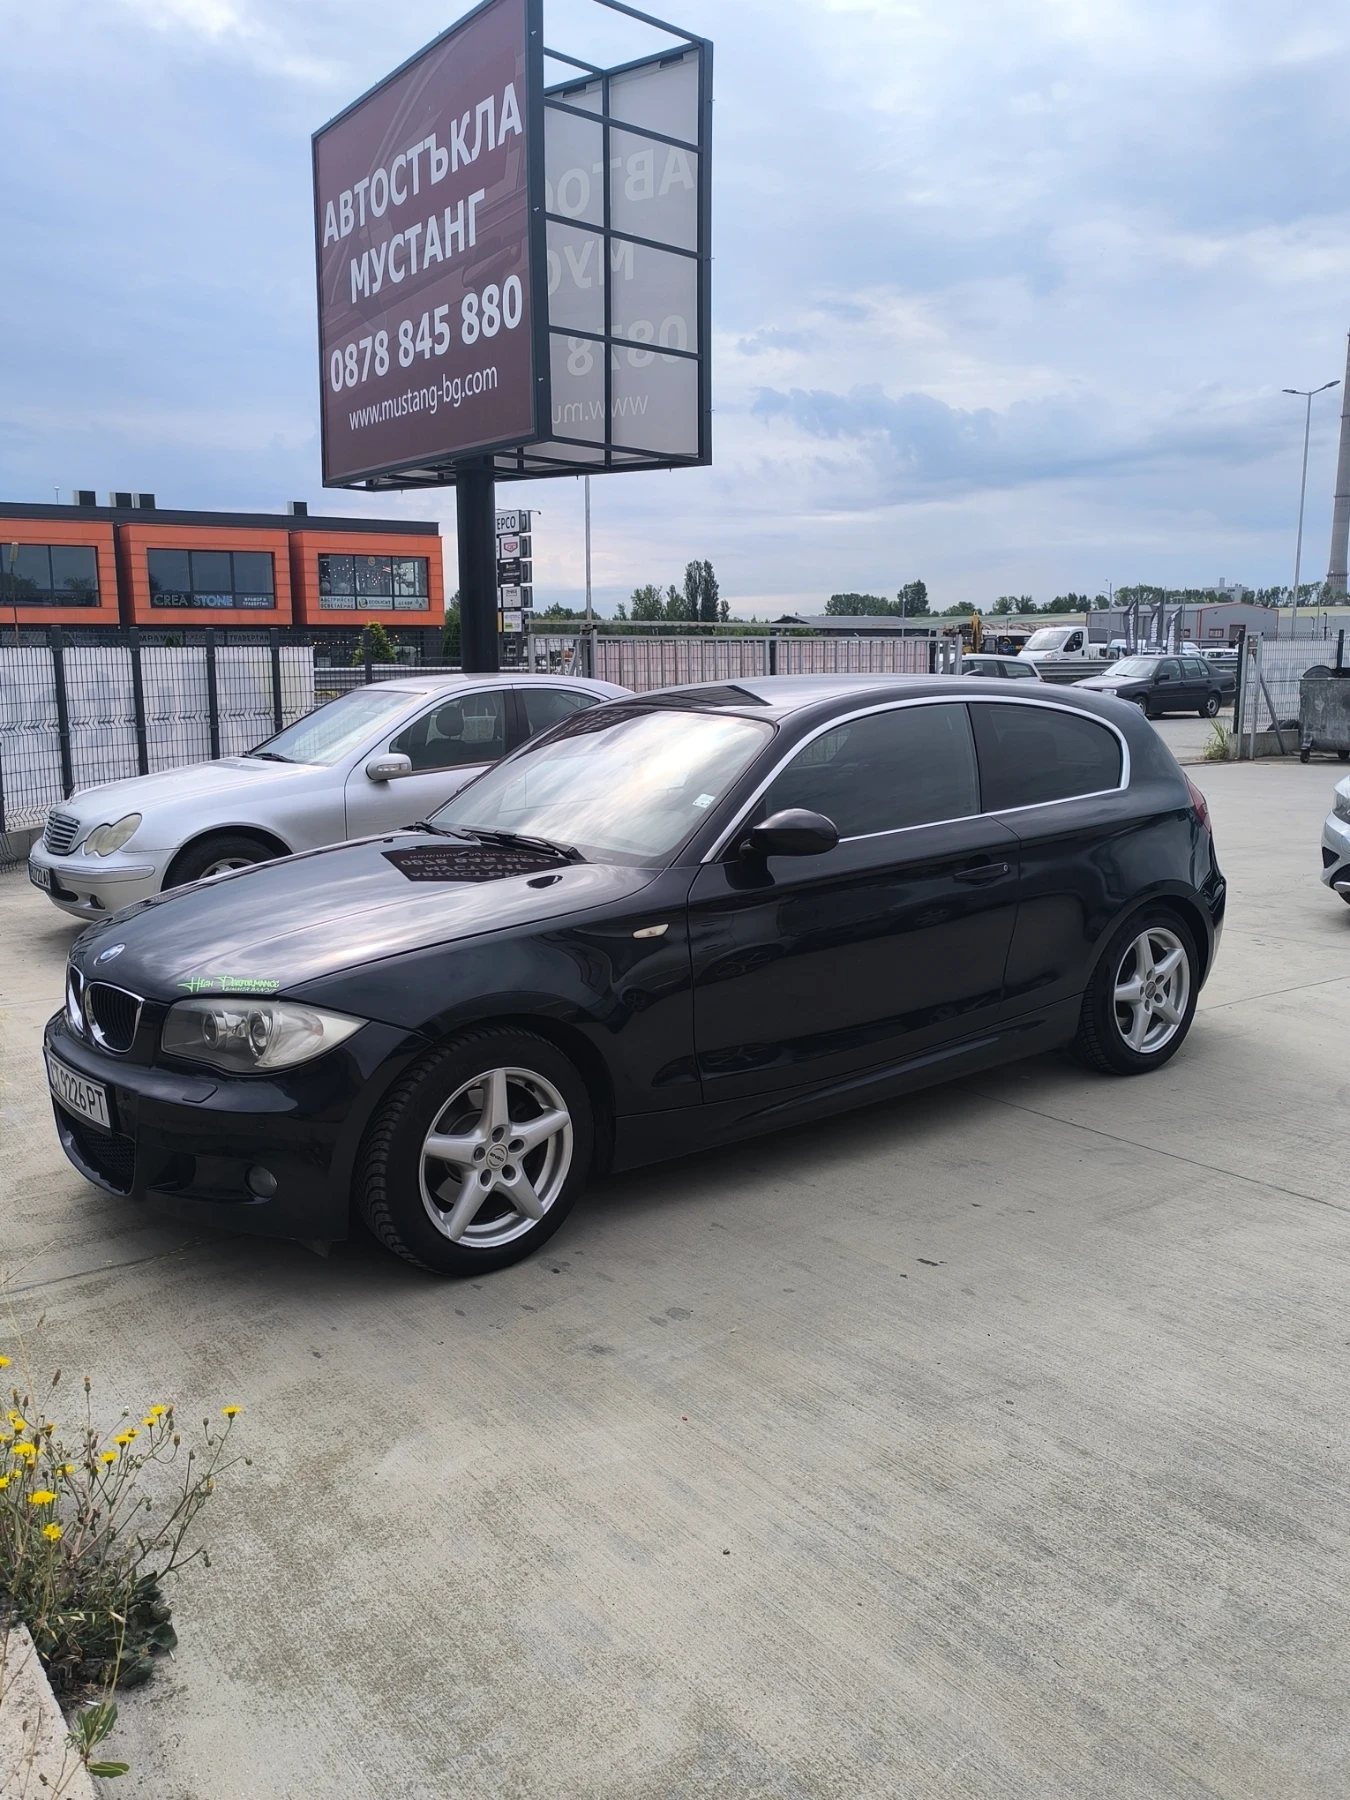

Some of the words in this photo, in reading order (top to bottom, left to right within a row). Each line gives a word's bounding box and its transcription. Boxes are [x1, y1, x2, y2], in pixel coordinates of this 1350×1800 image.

[323, 82, 523, 249] АВТОСТЪКЛА
[350, 188, 485, 304] МУСТАНГ
[330, 330, 390, 393] 0878
[399, 303, 451, 368] 845
[461, 274, 523, 345] 880
[349, 366, 498, 431] www.mustang-bg.com
[153, 594, 188, 606] CREA
[193, 595, 233, 607] STONE
[490, 1152, 504, 1162] ENZO
